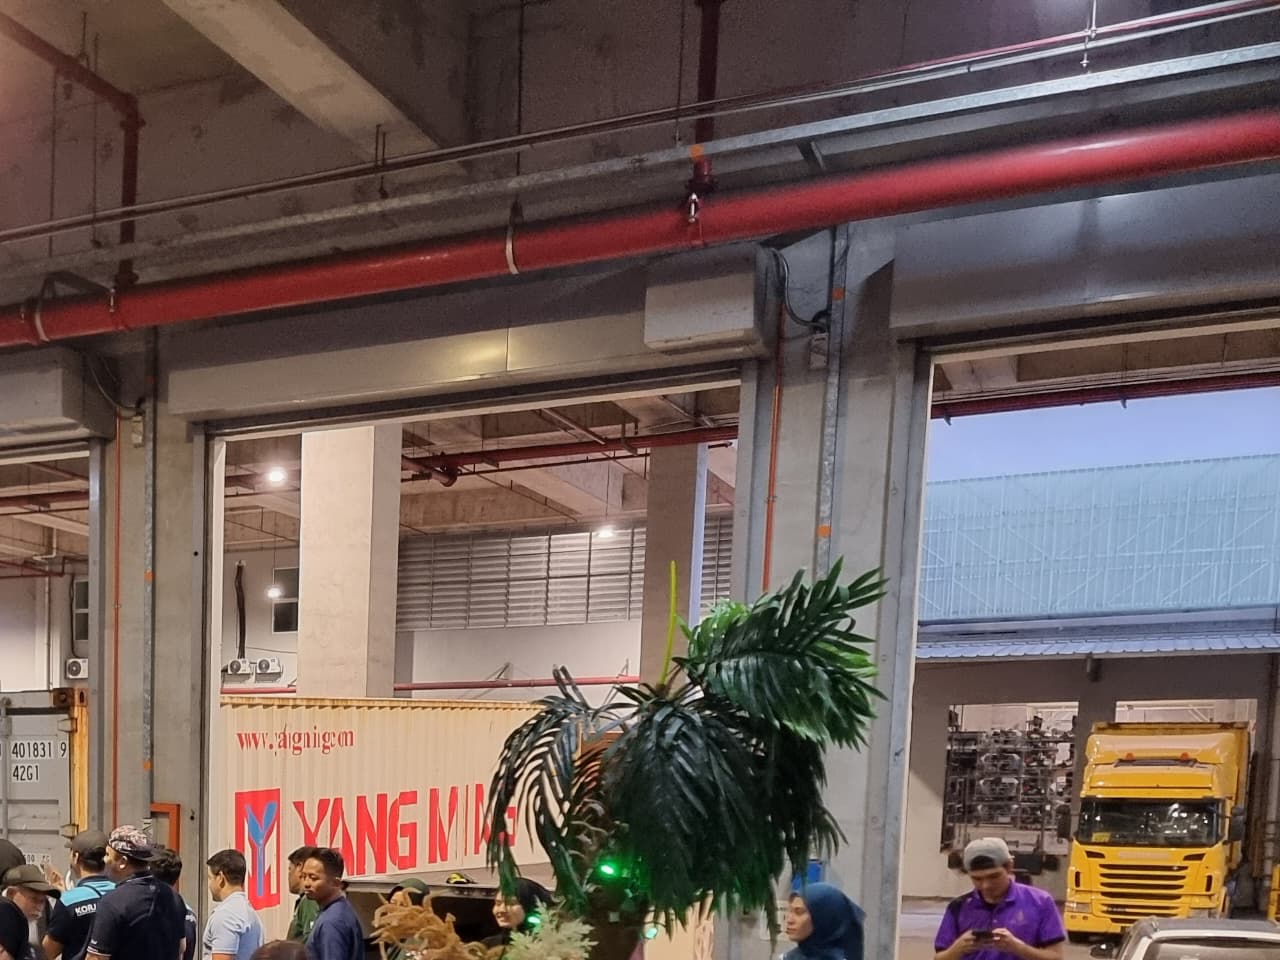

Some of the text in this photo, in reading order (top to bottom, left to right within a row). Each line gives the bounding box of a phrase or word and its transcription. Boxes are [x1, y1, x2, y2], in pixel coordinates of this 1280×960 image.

[11, 742, 52, 759] 401831
[60, 741, 67, 758] 9
[12, 765, 39, 781] 42G1
[292, 790, 418, 877] YANG
